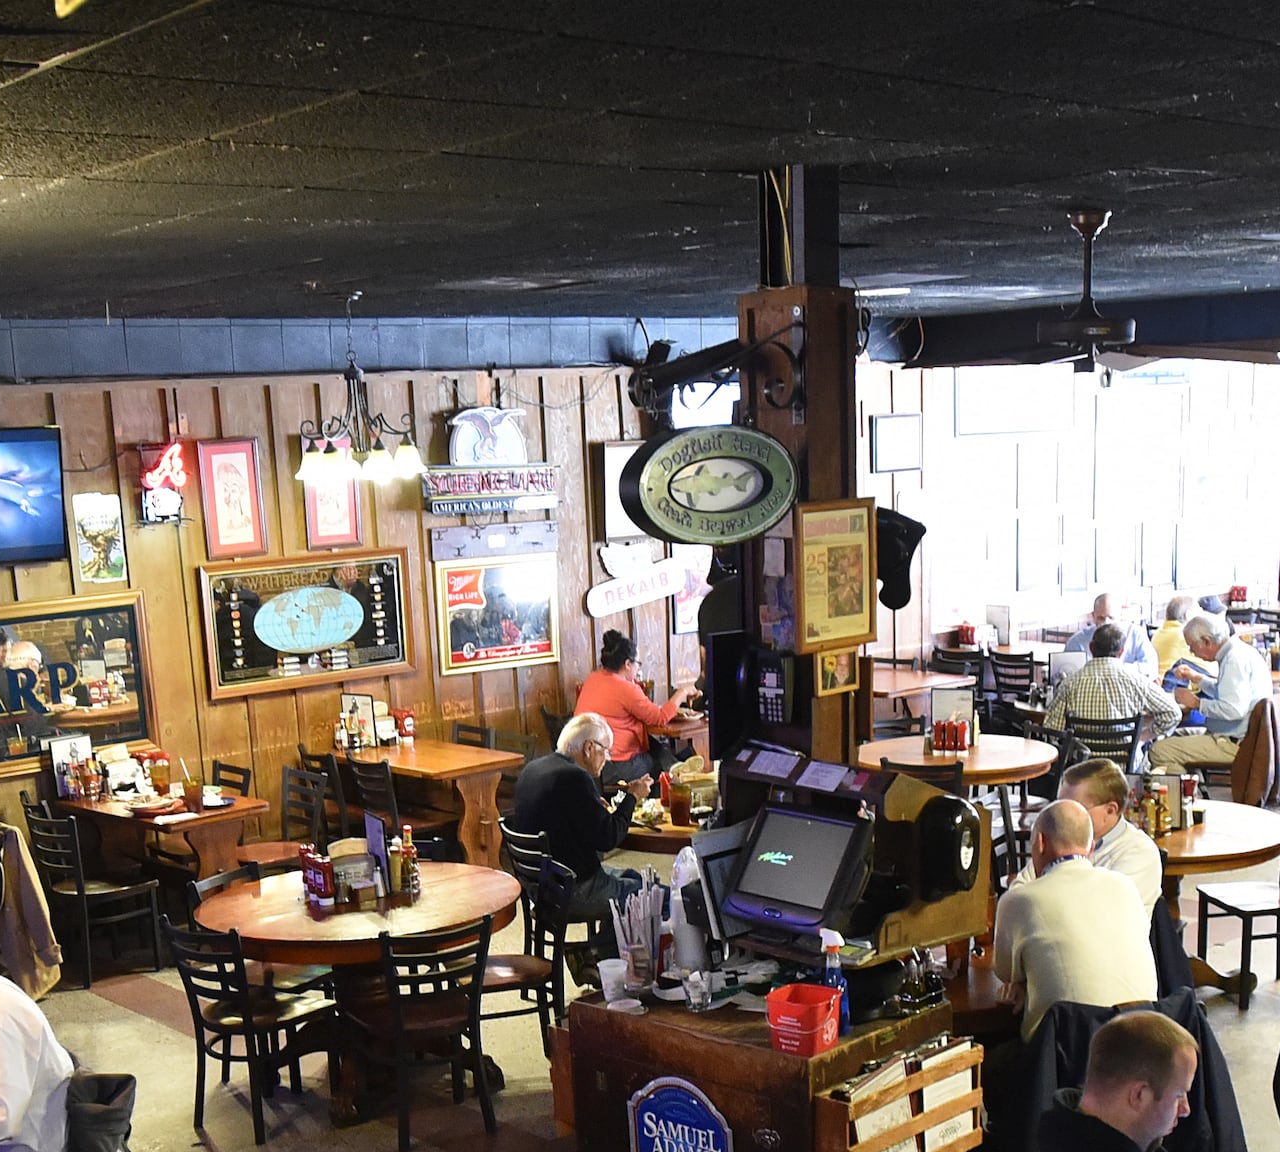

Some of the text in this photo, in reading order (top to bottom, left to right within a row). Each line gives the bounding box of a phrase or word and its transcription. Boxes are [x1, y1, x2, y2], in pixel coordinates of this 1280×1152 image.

[806, 552, 827, 576] 25
[246, 571, 330, 590] WHITBREAD
[448, 591, 479, 600] HIGH LIFE
